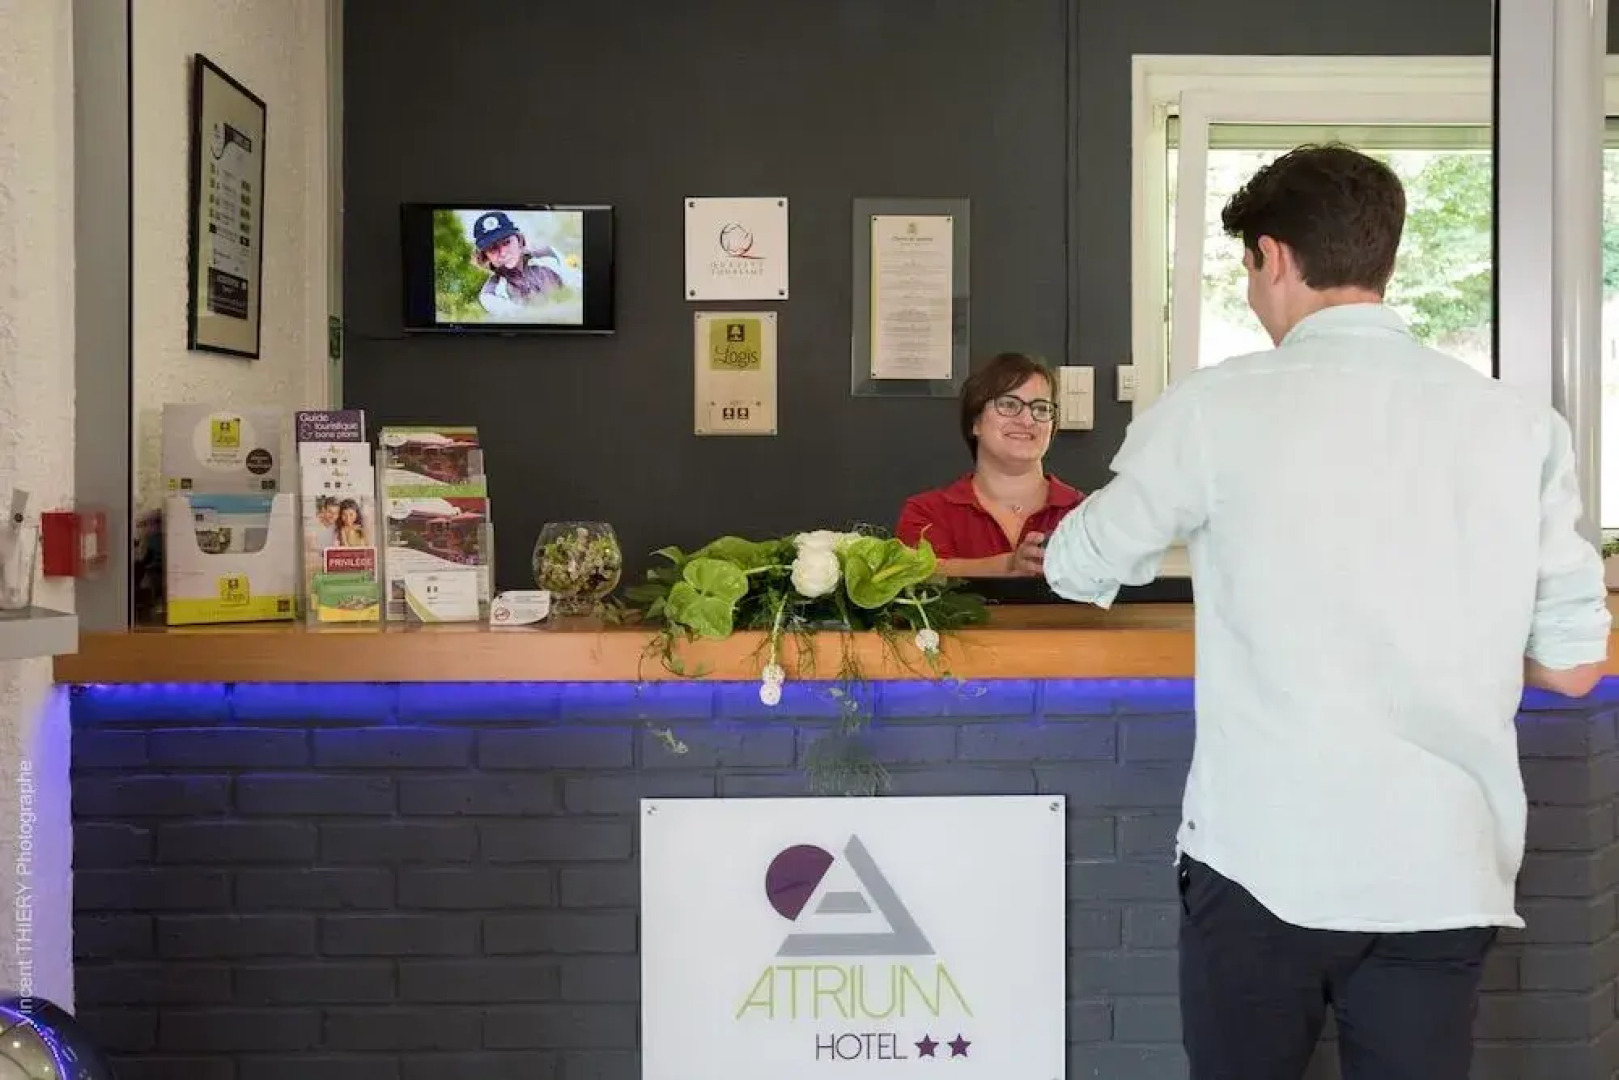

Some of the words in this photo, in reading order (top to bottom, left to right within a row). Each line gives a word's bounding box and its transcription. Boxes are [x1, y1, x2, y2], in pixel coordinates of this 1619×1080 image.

[713, 344, 759, 368] Logis
[299, 412, 330, 422] Guide
[736, 963, 973, 1020] ATRIUM
[815, 1032, 908, 1061] HOTEL
